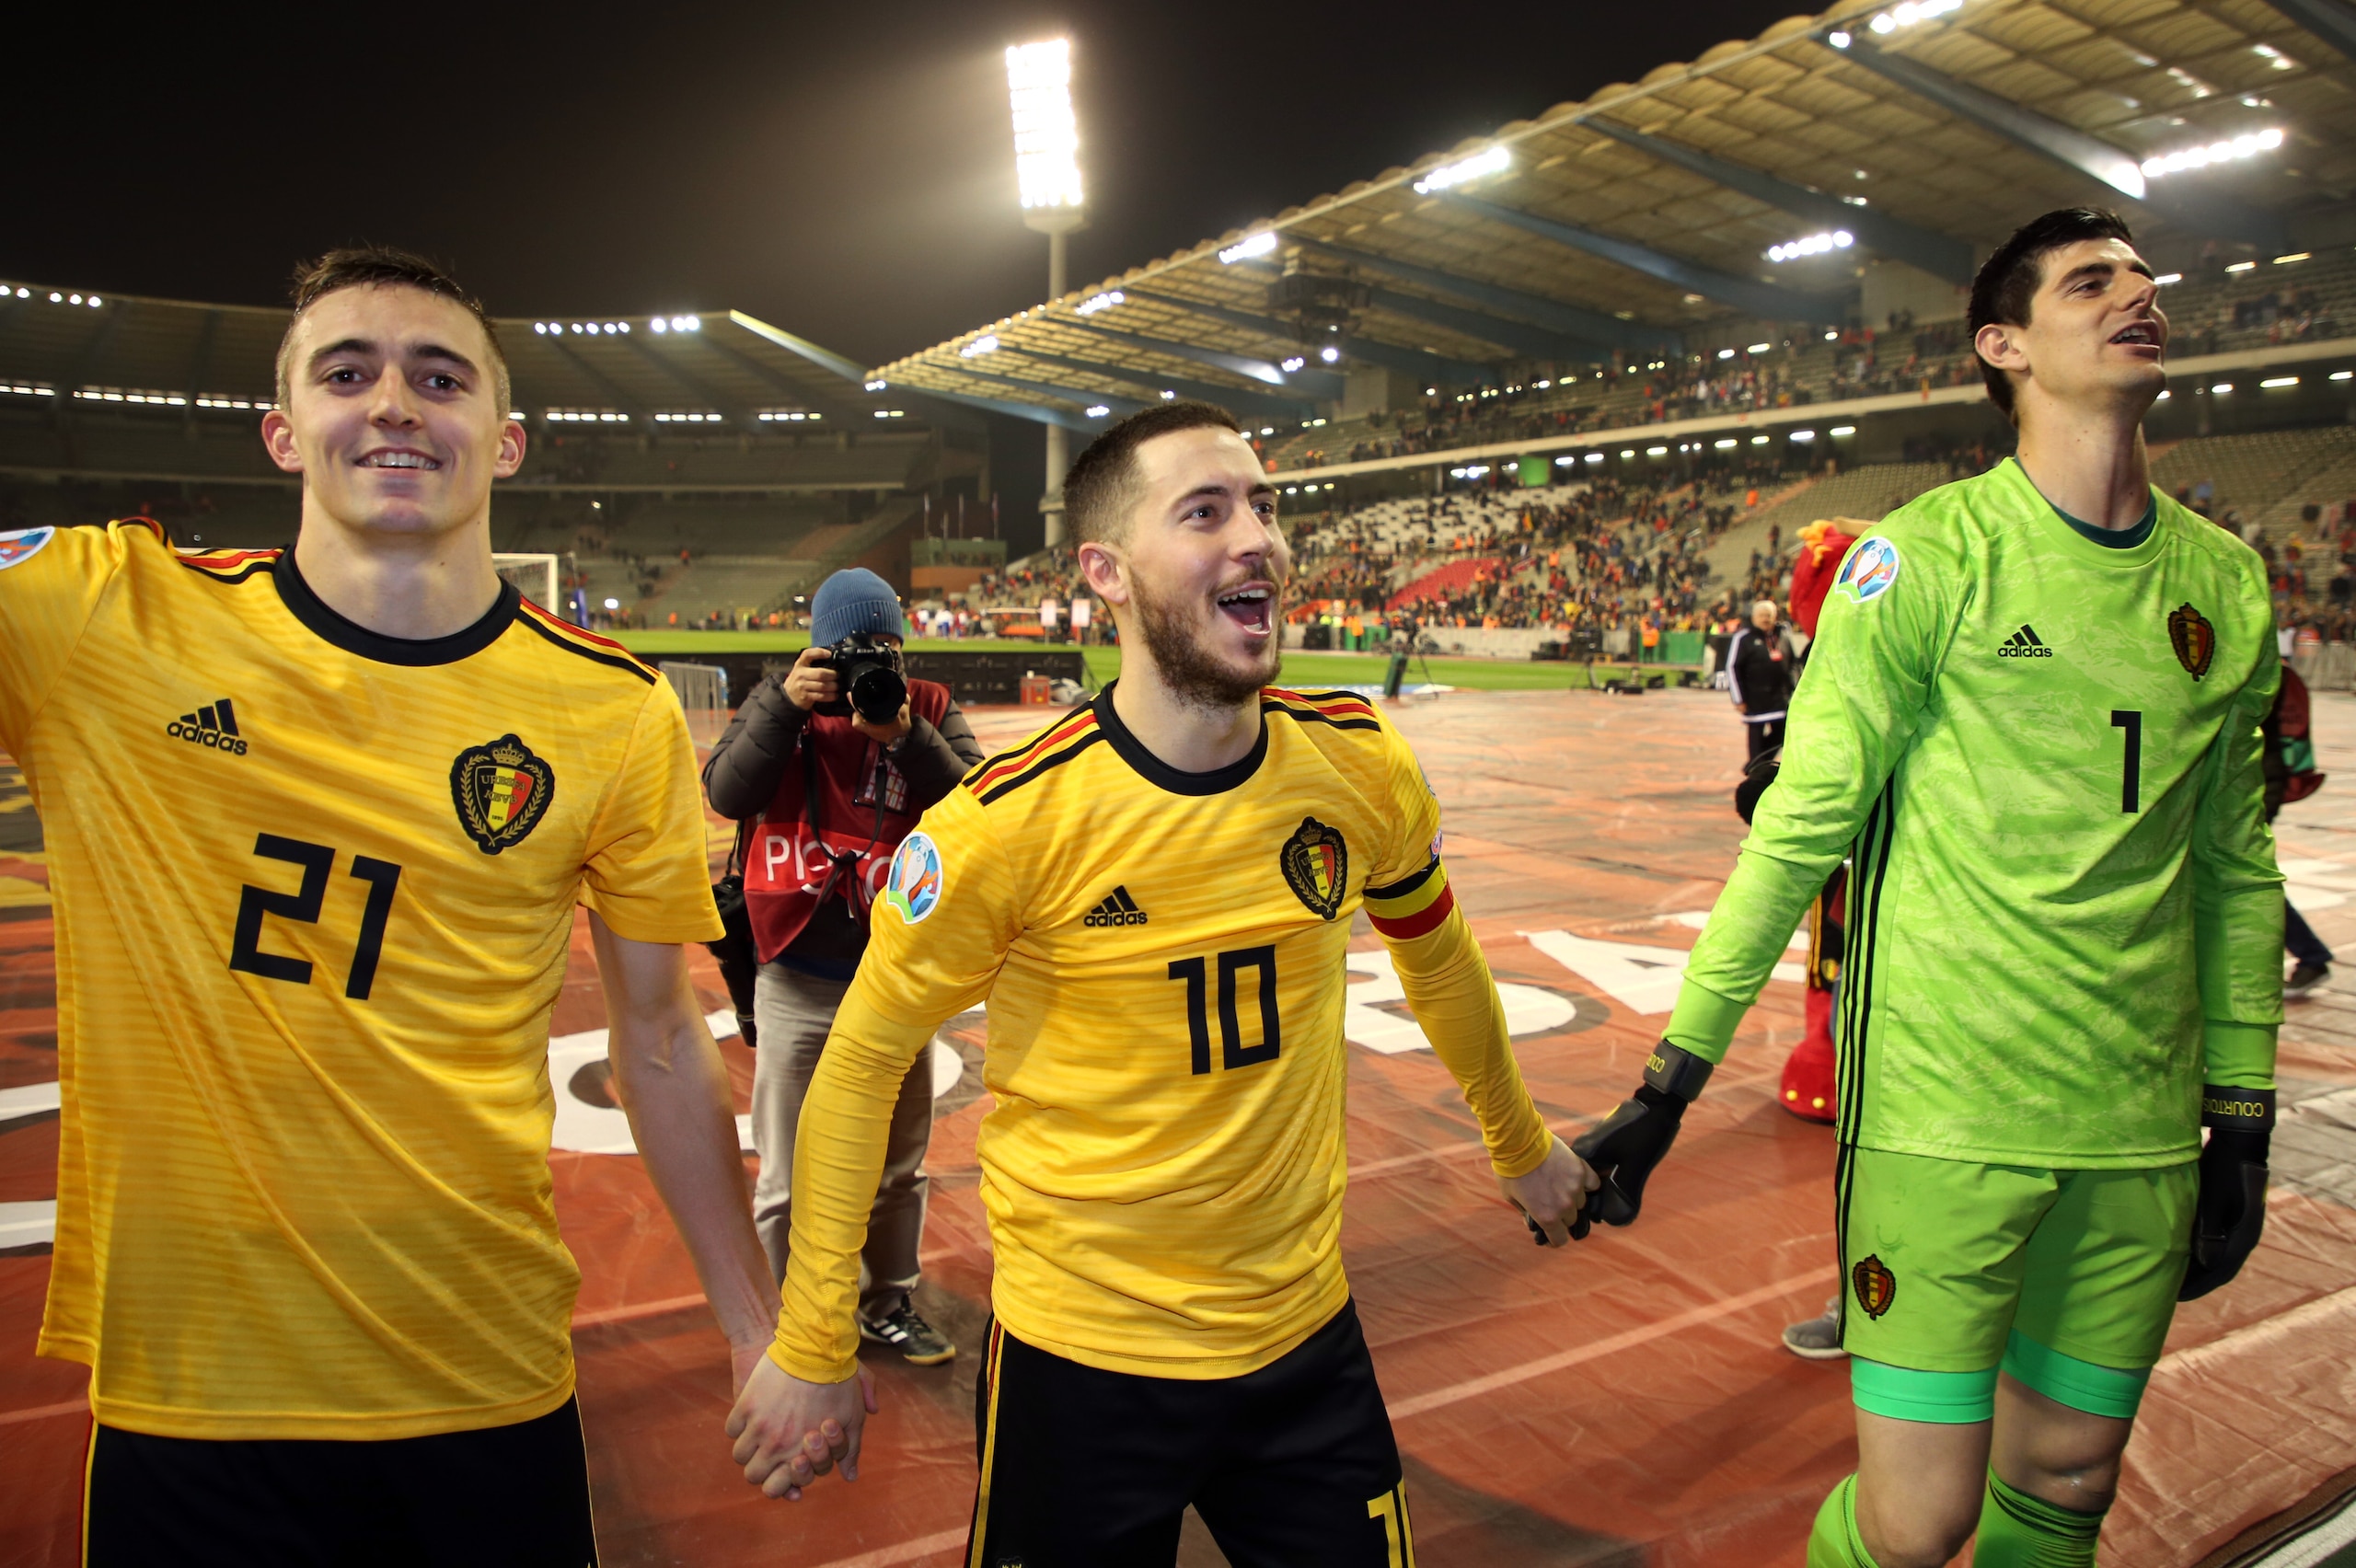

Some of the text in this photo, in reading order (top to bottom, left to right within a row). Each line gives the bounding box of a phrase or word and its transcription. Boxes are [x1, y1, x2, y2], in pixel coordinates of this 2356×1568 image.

[1997, 645, 2053, 658] adidas
[167, 721, 248, 755] adidas
[2111, 709, 2142, 813] 1
[229, 832, 402, 1000] 21
[1084, 911, 1148, 928] adidas
[1168, 944, 1280, 1076] 10
